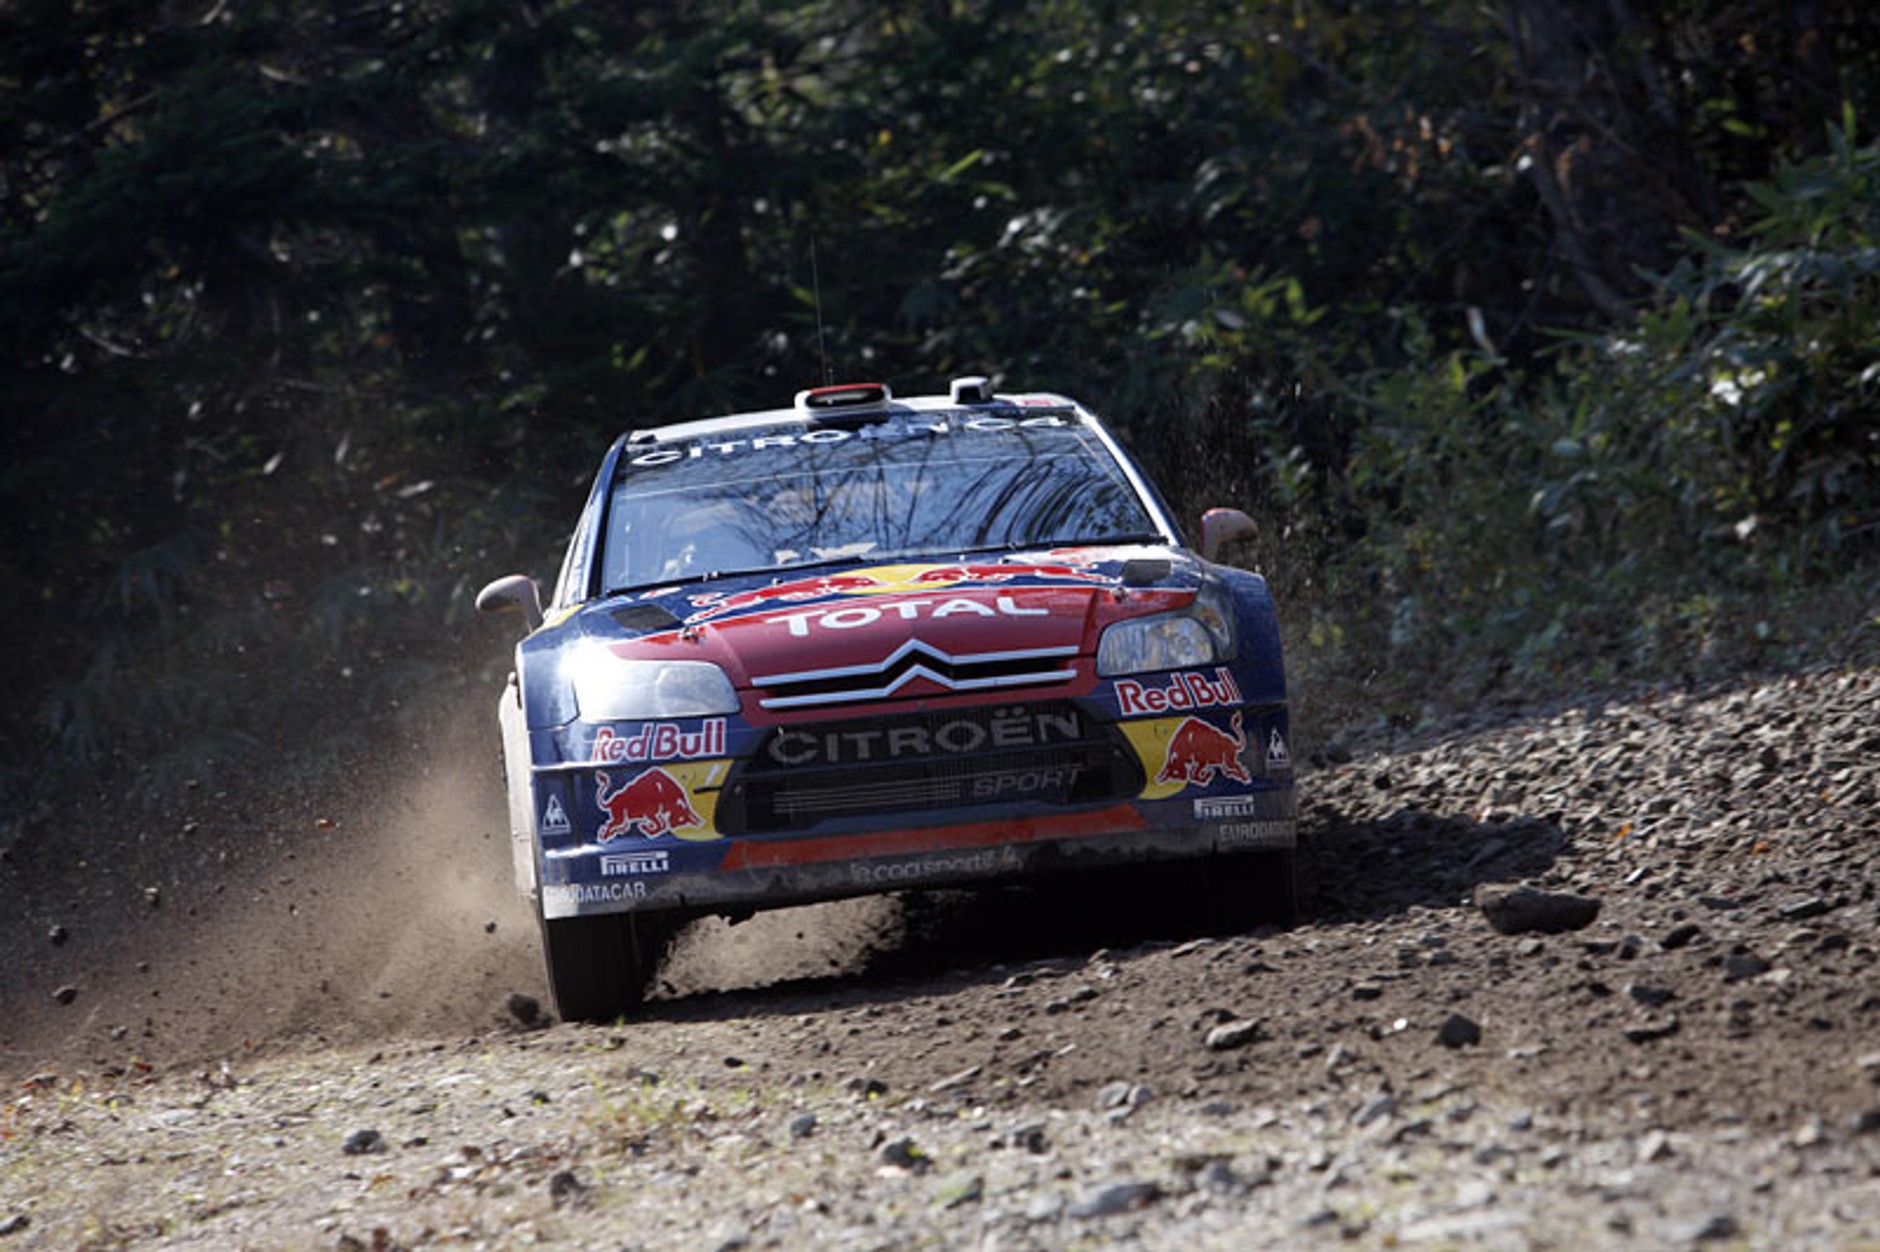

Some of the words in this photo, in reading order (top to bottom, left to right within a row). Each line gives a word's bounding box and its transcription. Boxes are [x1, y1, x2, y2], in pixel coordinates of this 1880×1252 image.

[764, 597, 1049, 636] TOTAL
[1114, 672, 1193, 716] Red
[1185, 666, 1243, 706] Bull
[591, 723, 654, 763] Red
[652, 717, 727, 760] Bull
[769, 707, 1082, 764] CITROËN
[973, 765, 1086, 797] SPORT
[1194, 795, 1255, 818] PIRELLI
[601, 851, 670, 875] PIRELLI
